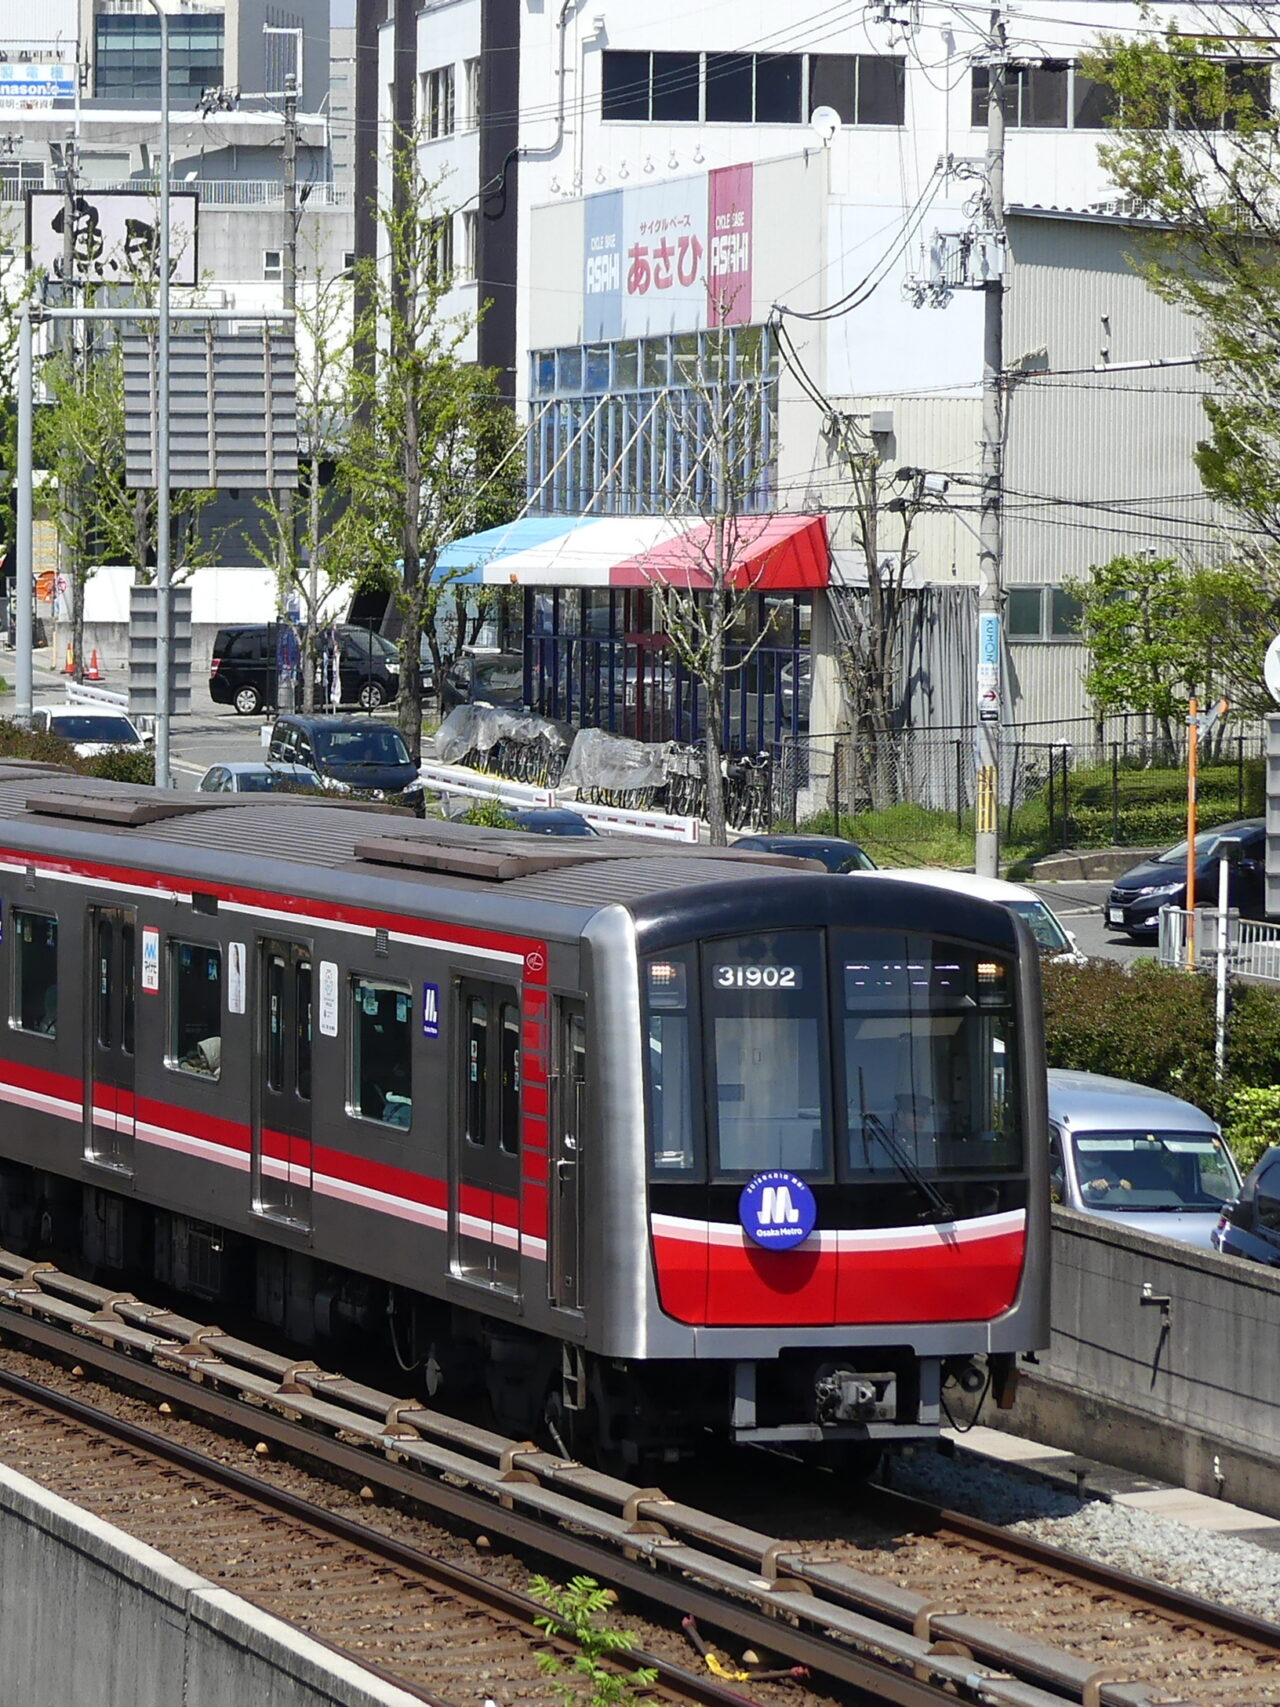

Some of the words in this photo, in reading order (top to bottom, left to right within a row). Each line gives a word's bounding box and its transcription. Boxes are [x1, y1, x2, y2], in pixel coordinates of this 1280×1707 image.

[639, 214, 691, 236] サイクルベース
[715, 212, 730, 231] CYCLE
[591, 236, 604, 251] CYCLE
[605, 234, 616, 248] BASE
[627, 234, 704, 295] あさひ
[710, 232, 749, 276] ASAHI
[587, 253, 620, 294] ASAHI
[984, 620, 996, 662] KUMON
[718, 966, 796, 987] 31902
[756, 1229, 780, 1237] Osaka
[780, 1228, 803, 1236] Metro
